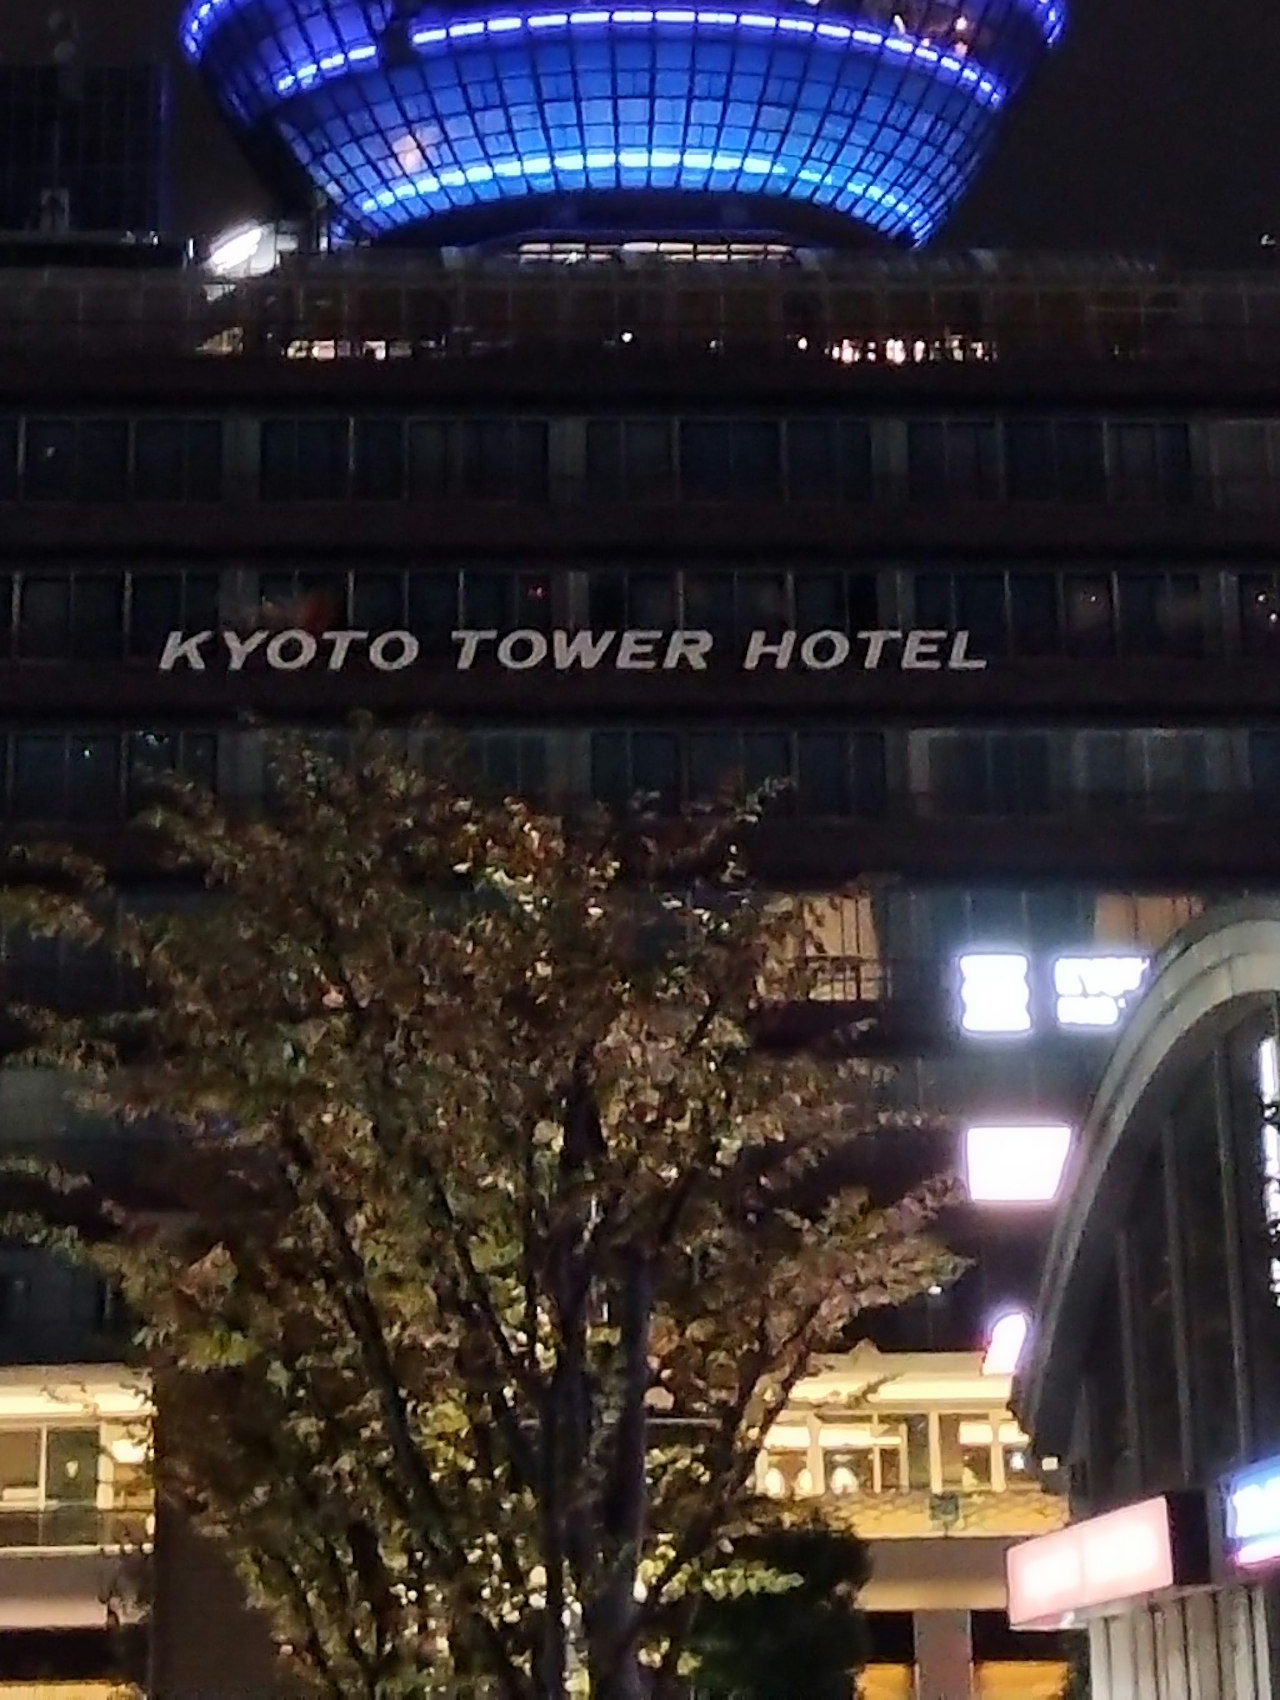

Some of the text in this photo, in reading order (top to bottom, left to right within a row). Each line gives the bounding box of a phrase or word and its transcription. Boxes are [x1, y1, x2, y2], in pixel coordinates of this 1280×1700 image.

[158, 629, 989, 670] KYOTO TOWER HOTEL
